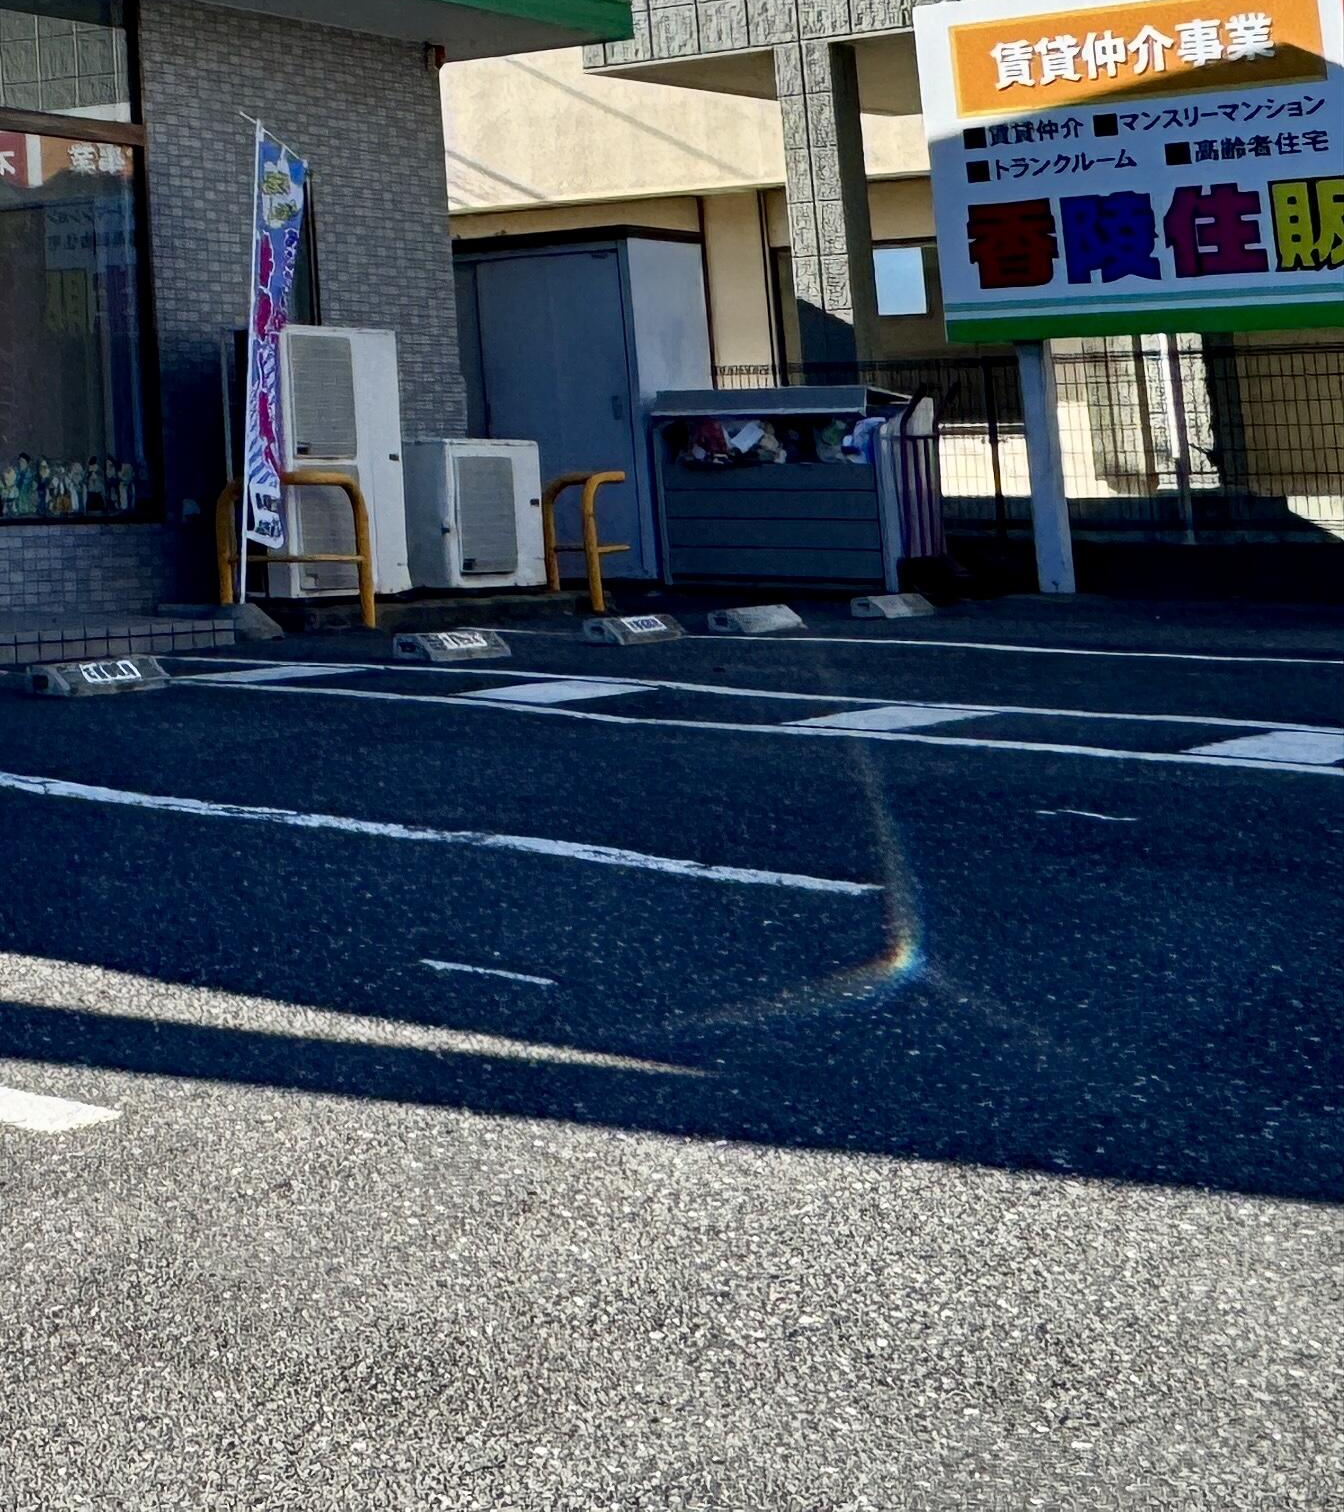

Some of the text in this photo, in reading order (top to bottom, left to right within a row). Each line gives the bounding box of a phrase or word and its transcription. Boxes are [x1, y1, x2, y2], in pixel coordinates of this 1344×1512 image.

[989, 11, 1277, 91] 賃貸仲介事業
[989, 94, 1327, 146] 賃貸仲介 マンスリーマンション
[995, 128, 1331, 180] トランクルーム 高齢者住宅
